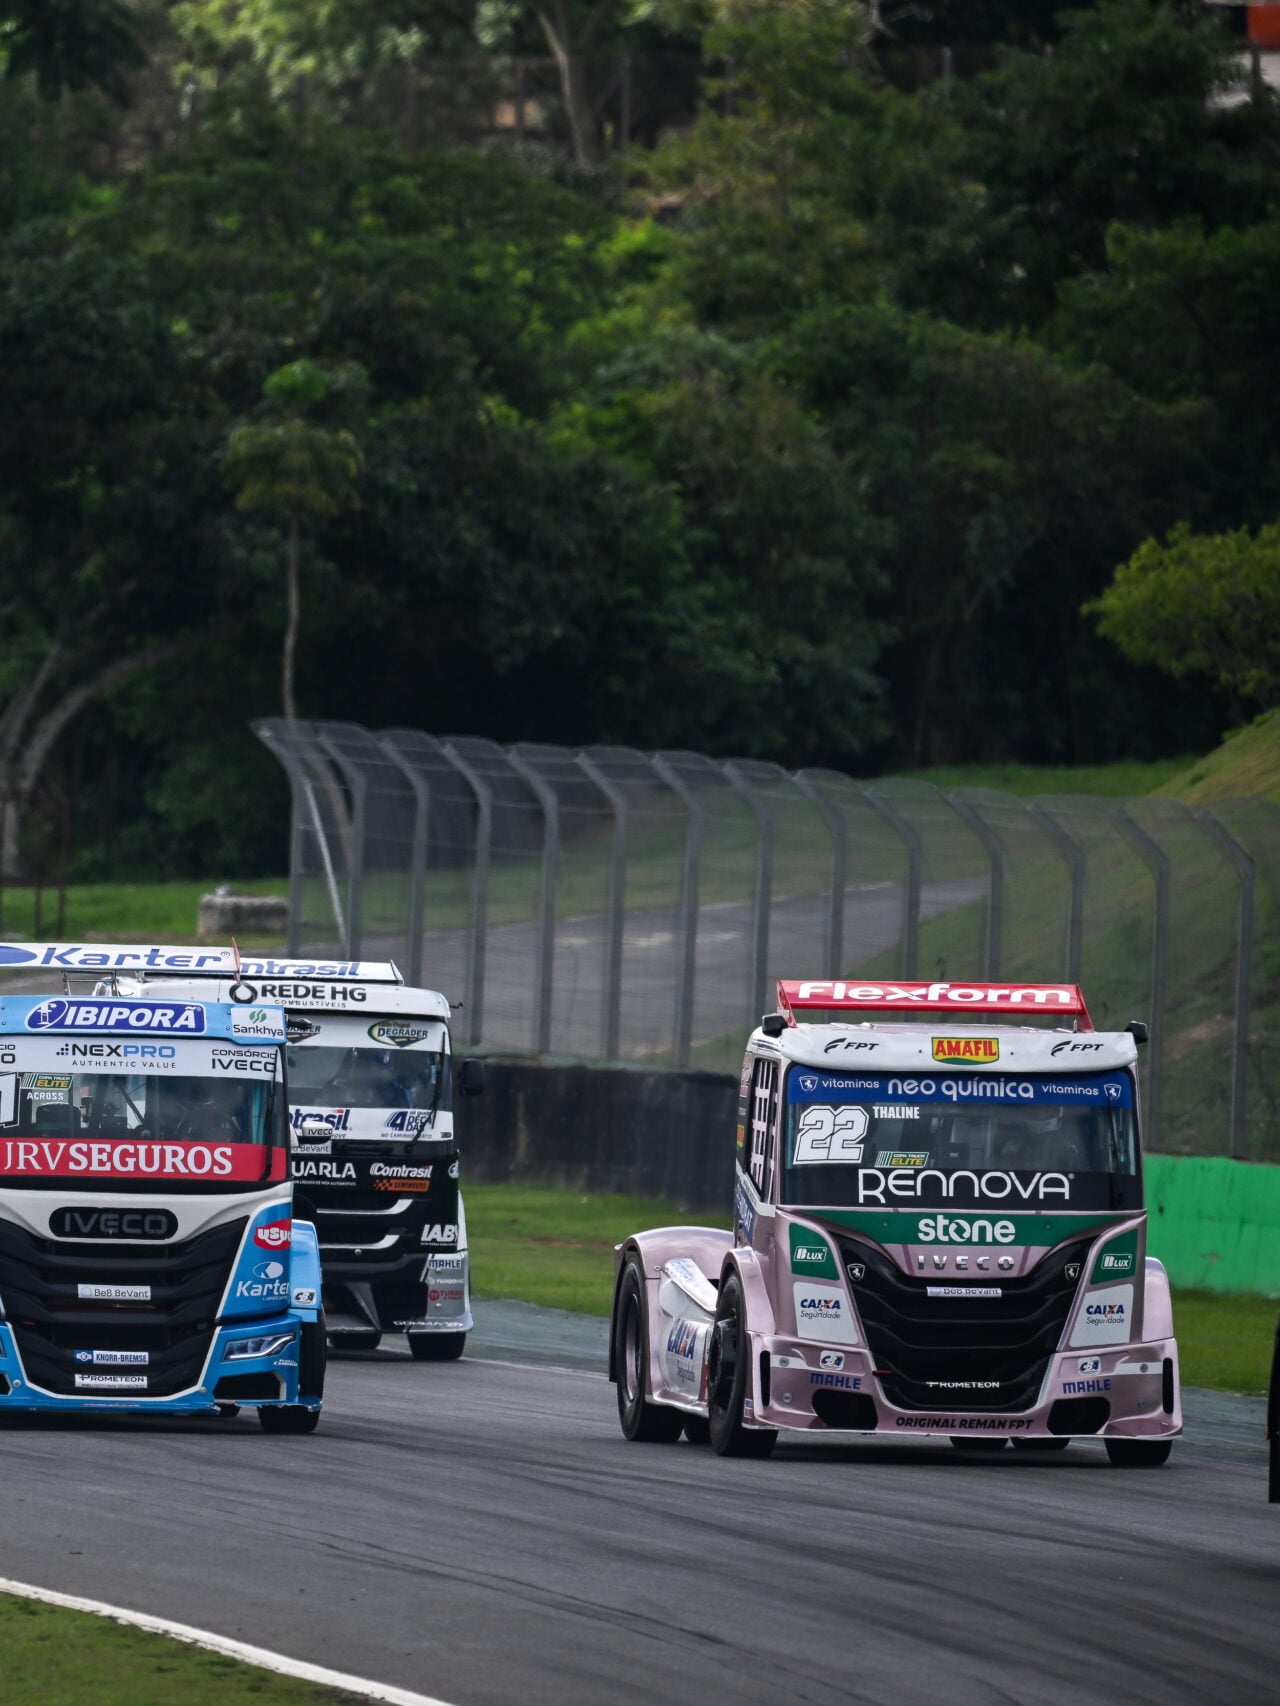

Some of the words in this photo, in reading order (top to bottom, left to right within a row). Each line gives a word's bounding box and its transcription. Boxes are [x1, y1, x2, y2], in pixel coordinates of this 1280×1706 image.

[41, 947, 221, 968] Karter
[261, 984, 325, 999] REDE
[331, 986, 367, 1002] HG
[798, 982, 1071, 1003] Flexform
[274, 1000, 347, 1008] COMBUSTÍVEIS
[64, 1002, 197, 1030] IBIPORÃ
[233, 1024, 284, 1037] Sankhya
[377, 1027, 428, 1038] DEGRADER
[72, 1043, 176, 1058] NEXPRO
[844, 1040, 880, 1051] FPT
[934, 1040, 997, 1057] AMAFIL
[1070, 1043, 1104, 1053] FPT
[212, 1048, 277, 1060] CONSÓRCIO
[72, 1060, 137, 1068] AUTHENTIC
[142, 1061, 176, 1069] VALUE
[212, 1058, 277, 1073] IVECO
[36, 1080, 69, 1088] ELITE
[821, 1078, 880, 1089] vitaminas
[888, 1078, 935, 1095] neo
[941, 1078, 1034, 1101] química
[1041, 1084, 1099, 1095] vitaminas
[26, 1092, 64, 1101] ACROSS
[872, 1106, 920, 1119] THALINE
[794, 1105, 869, 1165] 22
[891, 1157, 924, 1165] ELITE
[291, 1161, 357, 1179] UARLA
[370, 1163, 433, 1179] Comtrasil
[65, 1213, 167, 1234] IVECO
[918, 1215, 1016, 1243] stone
[428, 1260, 462, 1269] MAHLE
[918, 1255, 1016, 1271] IVECO
[95, 1289, 113, 1297] Be8
[115, 1289, 149, 1298] BeVant
[800, 1298, 841, 1311] CAIXA
[1086, 1304, 1124, 1316] CAIXA
[800, 1310, 841, 1320] Seguridade
[1086, 1315, 1124, 1325] Seguridade
[667, 1318, 698, 1360] CAIXA
[96, 1353, 148, 1363] KNORR-BREMSE
[80, 1374, 145, 1383] PROMETEON
[810, 1373, 862, 1390] MAHLE
[1063, 1379, 1111, 1395] MAHLE
[896, 1416, 957, 1429] ORIGINAL
[959, 1418, 1006, 1430] REMAN
[1009, 1419, 1033, 1431] FPT
